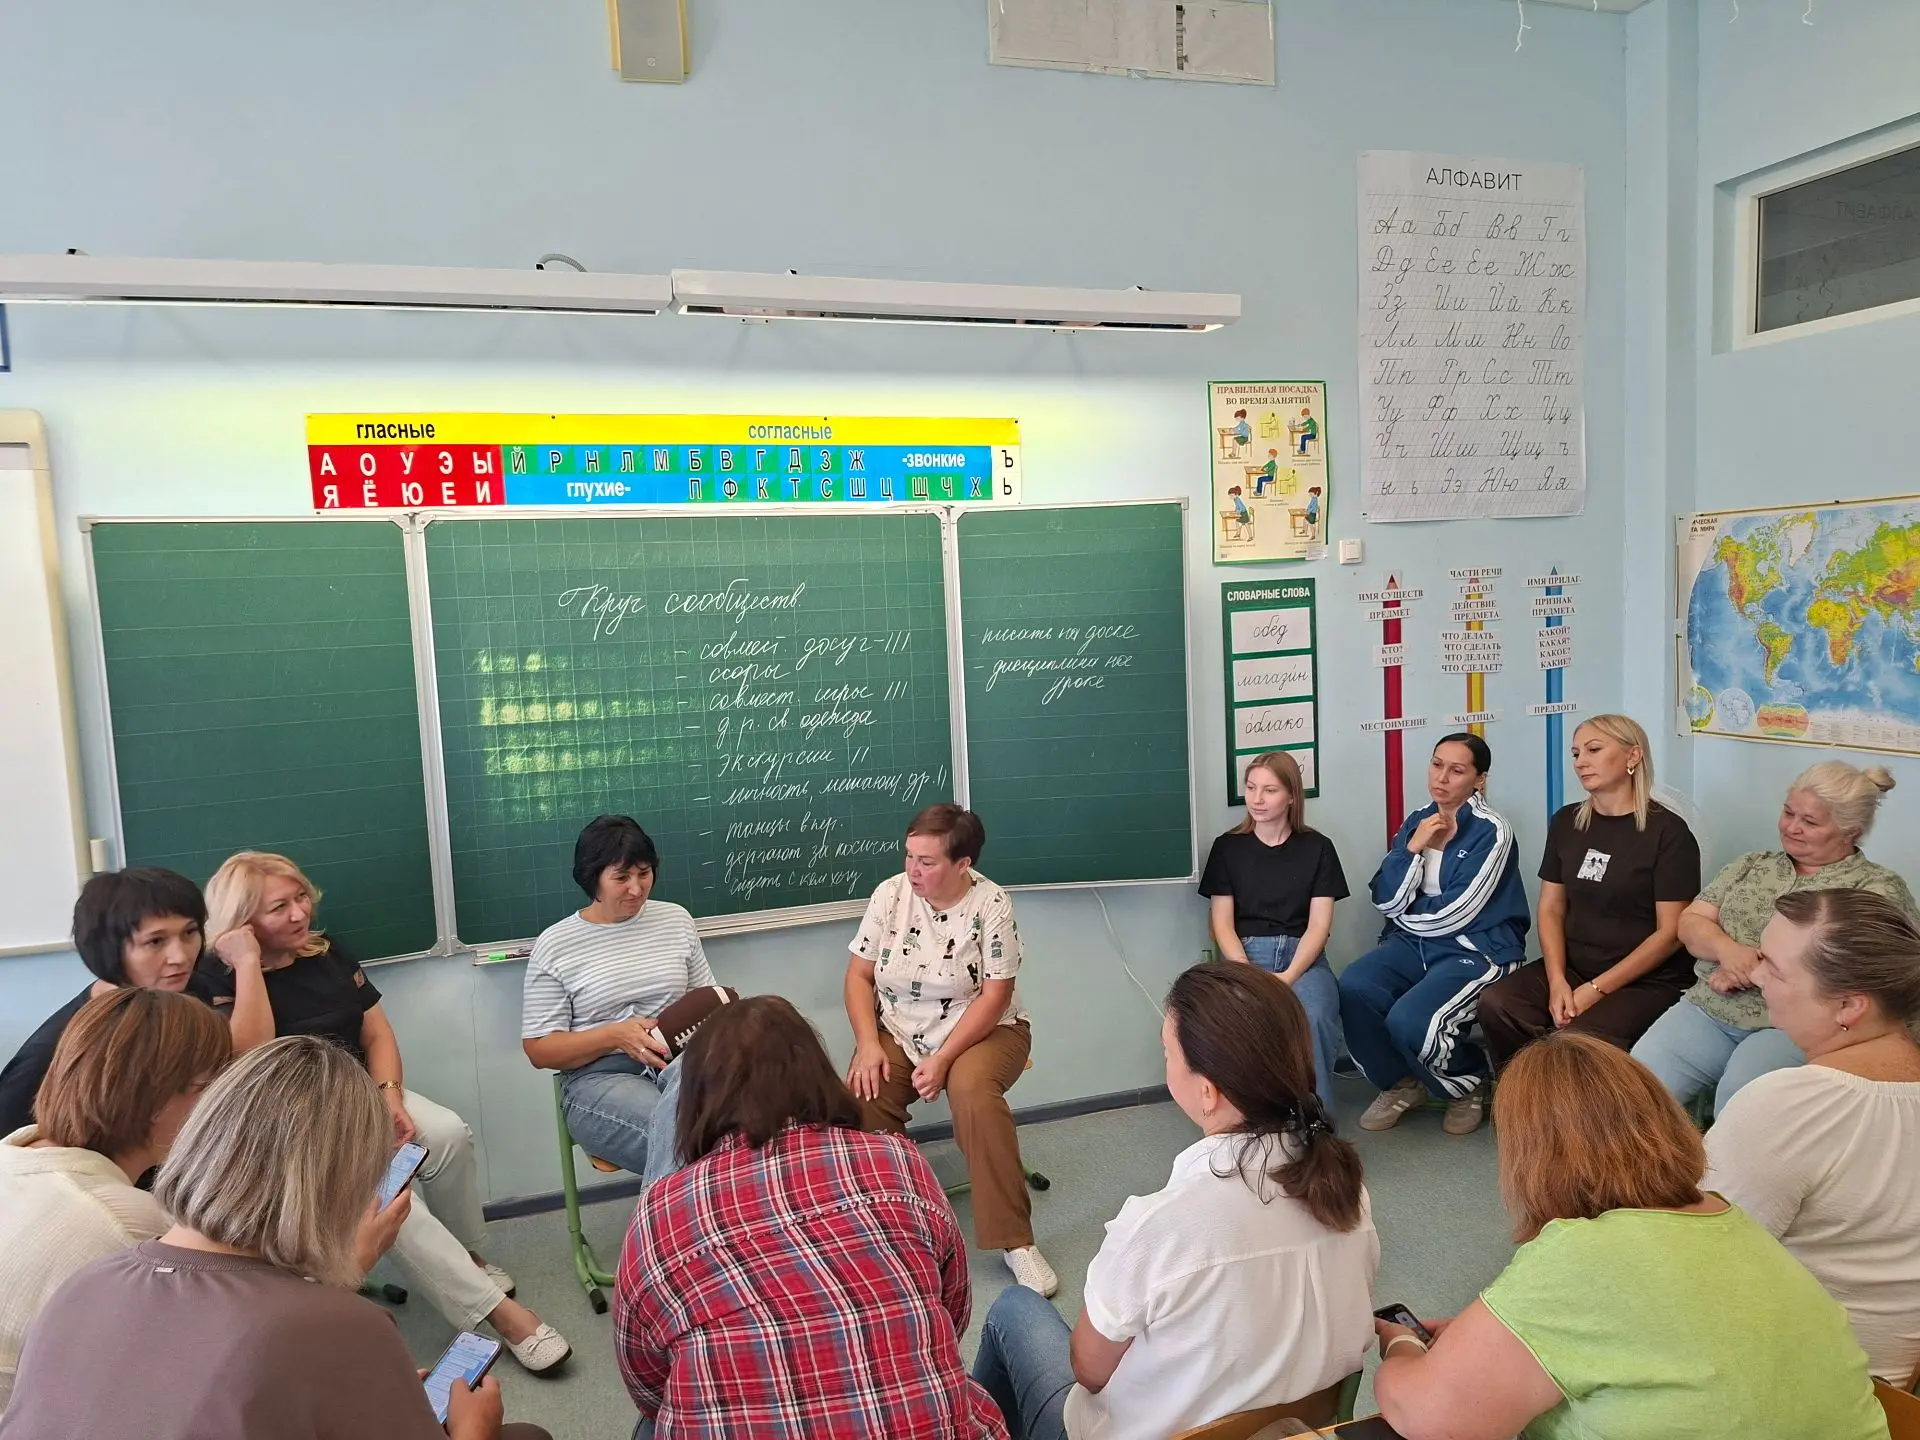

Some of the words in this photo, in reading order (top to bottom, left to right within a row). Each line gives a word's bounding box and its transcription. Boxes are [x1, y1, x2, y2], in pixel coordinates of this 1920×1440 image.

[1426, 168, 1522, 190] АЛФАВИТ
[1217, 386, 1277, 394] ПРАВИЛЬНАЯ
[1278, 386, 1318, 394] ПОСАДКА
[1270, 396, 1311, 404] ЗАНЯТИЙ
[356, 423, 436, 439] гласные
[748, 423, 833, 440] согласные
[320, 453, 337, 476] А
[360, 454, 376, 476] О
[400, 452, 414, 475] У
[438, 452, 453, 475] Э
[472, 451, 493, 475] Ы
[511, 446, 527, 474] Й
[550, 450, 563, 473] Р
[586, 451, 600, 472] Н
[620, 451, 634, 472] Л
[654, 449, 670, 471] М
[689, 450, 702, 471] Б
[720, 450, 733, 471] В
[756, 450, 766, 471] Г
[789, 449, 802, 473] Д
[820, 450, 832, 472] З
[850, 450, 865, 471] Ж
[1002, 450, 1014, 468] Ъ
[322, 485, 339, 508] Я
[364, 480, 378, 507] Ё
[402, 484, 424, 506] Ю
[441, 482, 456, 505] Е
[476, 481, 492, 503] И
[689, 478, 702, 500] П
[723, 478, 738, 498] Ф
[758, 478, 769, 499] К
[790, 478, 800, 500] Т
[820, 478, 833, 499] С
[850, 477, 866, 498] Ш
[880, 477, 893, 501] Ц
[912, 476, 929, 501] Щ
[940, 477, 953, 497] Ч
[969, 476, 982, 498] Х
[1003, 478, 1013, 495] Ь
[1450, 570, 1479, 578] ЧАСТИ
[1482, 568, 1502, 576] РЕЧИ
[1528, 578, 1546, 586] ИМЯ
[1548, 576, 1582, 585] ПРИЛАГ.
[1227, 589, 1281, 602] СЛОВАРНЫЕ
[1282, 586, 1311, 599] СЛОВА
[1460, 584, 1493, 594] ГЛАГОЛ
[1358, 592, 1379, 601] ИМЯ
[1381, 590, 1424, 600] СУЩЕСТВ
[1452, 600, 1496, 611] ДЕЙСТВИЕ
[1536, 597, 1573, 606] ПРИЗНАК
[558, 584, 646, 641] Круг
[1370, 608, 1411, 619] ПРЕДМЕТ
[1454, 612, 1499, 621] ПРЕДМЕТА
[1532, 607, 1575, 616] ПРЕДМЕТА
[1442, 632, 1460, 640] ЧТО
[1461, 632, 1494, 641] ДЕЛАТЬ
[1539, 626, 1571, 638] КАКОЙ?
[982, 627, 1051, 645] писать
[1058, 628, 1078, 642] на
[1077, 625, 1141, 655] доске
[1539, 638, 1571, 648] КАКАЯ?
[1382, 646, 1403, 655] КТО?
[1464, 642, 1502, 651] СДЕЛАТЬ
[1445, 654, 1462, 662] ЧТО
[1464, 653, 1501, 662] ДЕЛАЕТ?
[1540, 648, 1571, 658] КАКОЕ?
[1382, 657, 1403, 665] ЧТО?
[1540, 658, 1572, 669] КАКИЕ?
[1442, 664, 1460, 672] ЧТО
[1462, 664, 1503, 672] СДЕЛАЕТ?
[709, 663, 792, 693] ссоры
[1042, 675, 1106, 705] уроке
[814, 683, 874, 713] игры
[1534, 703, 1577, 714] ПРЕДЛОГИ
[1454, 714, 1495, 723] ЧАСТИЦА
[800, 710, 877, 740] одежда
[1360, 718, 1428, 731] МЕСТОИМЕНИЕ
[725, 818, 791, 843] танцы
[808, 843, 829, 868] за
